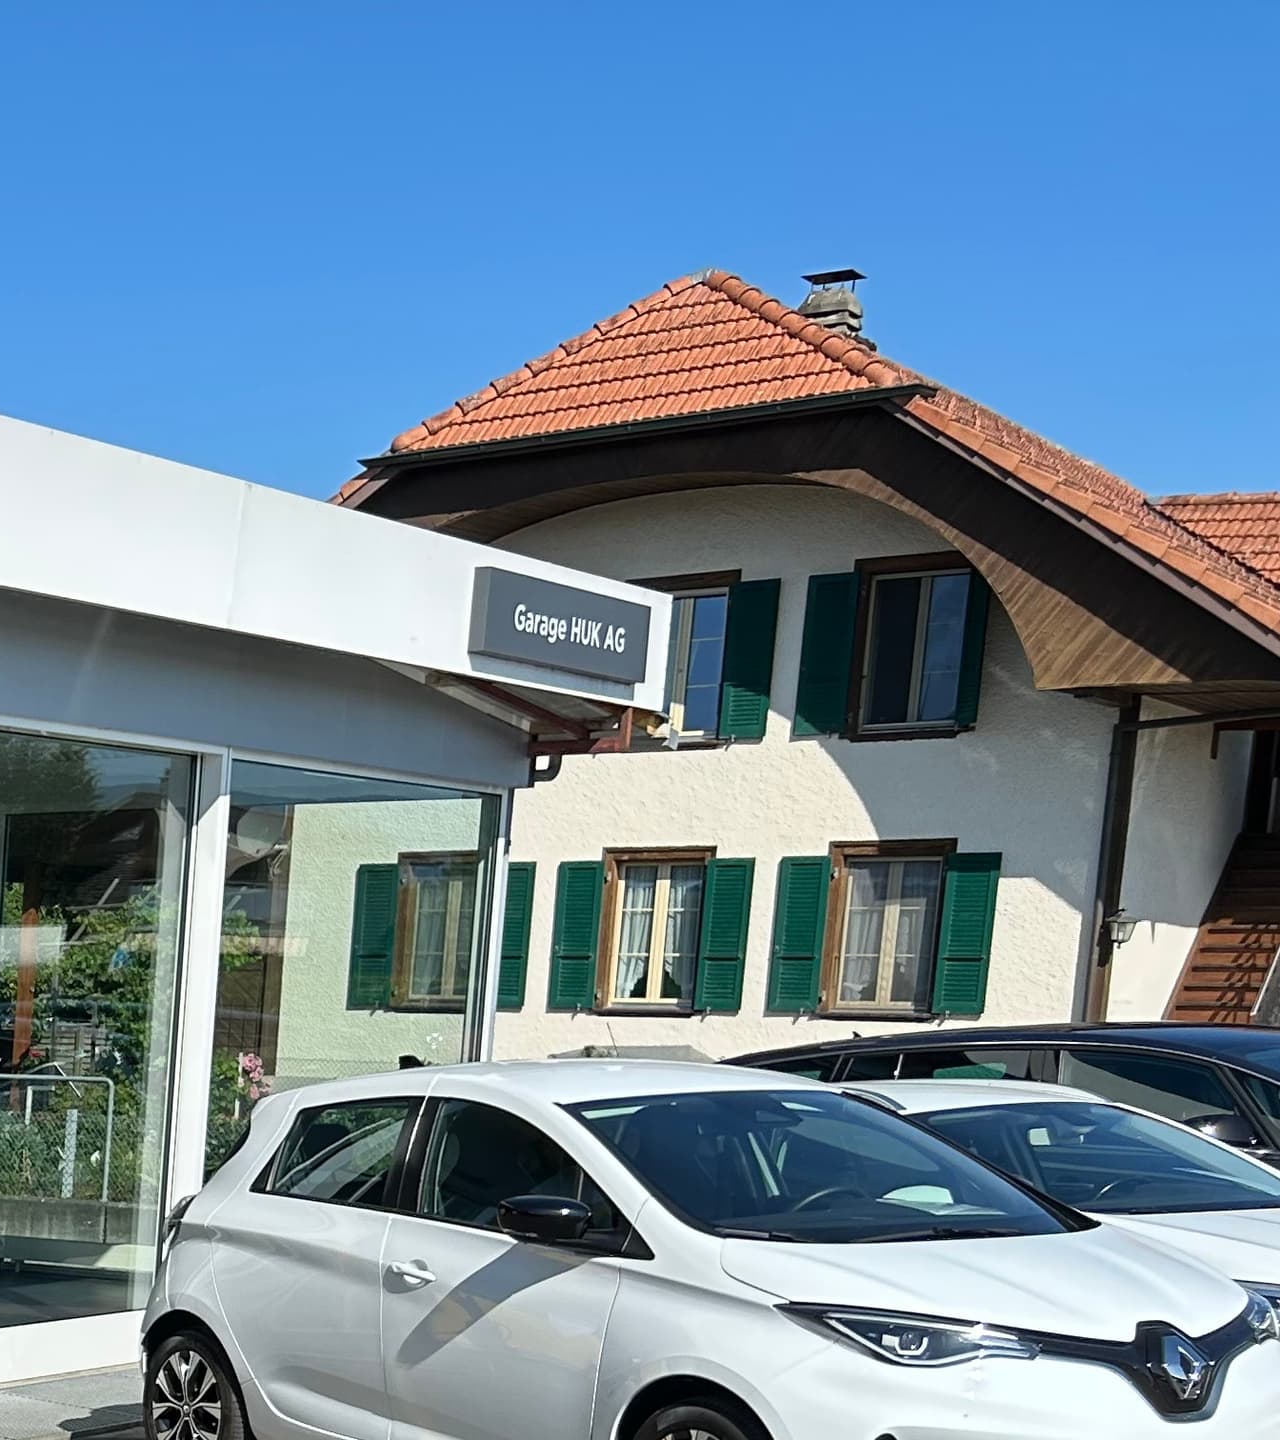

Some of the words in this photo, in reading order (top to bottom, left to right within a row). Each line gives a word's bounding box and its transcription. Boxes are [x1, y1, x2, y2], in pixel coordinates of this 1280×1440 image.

[513, 603, 568, 644] Garage
[570, 616, 603, 649] HUK
[603, 626, 627, 654] AG
